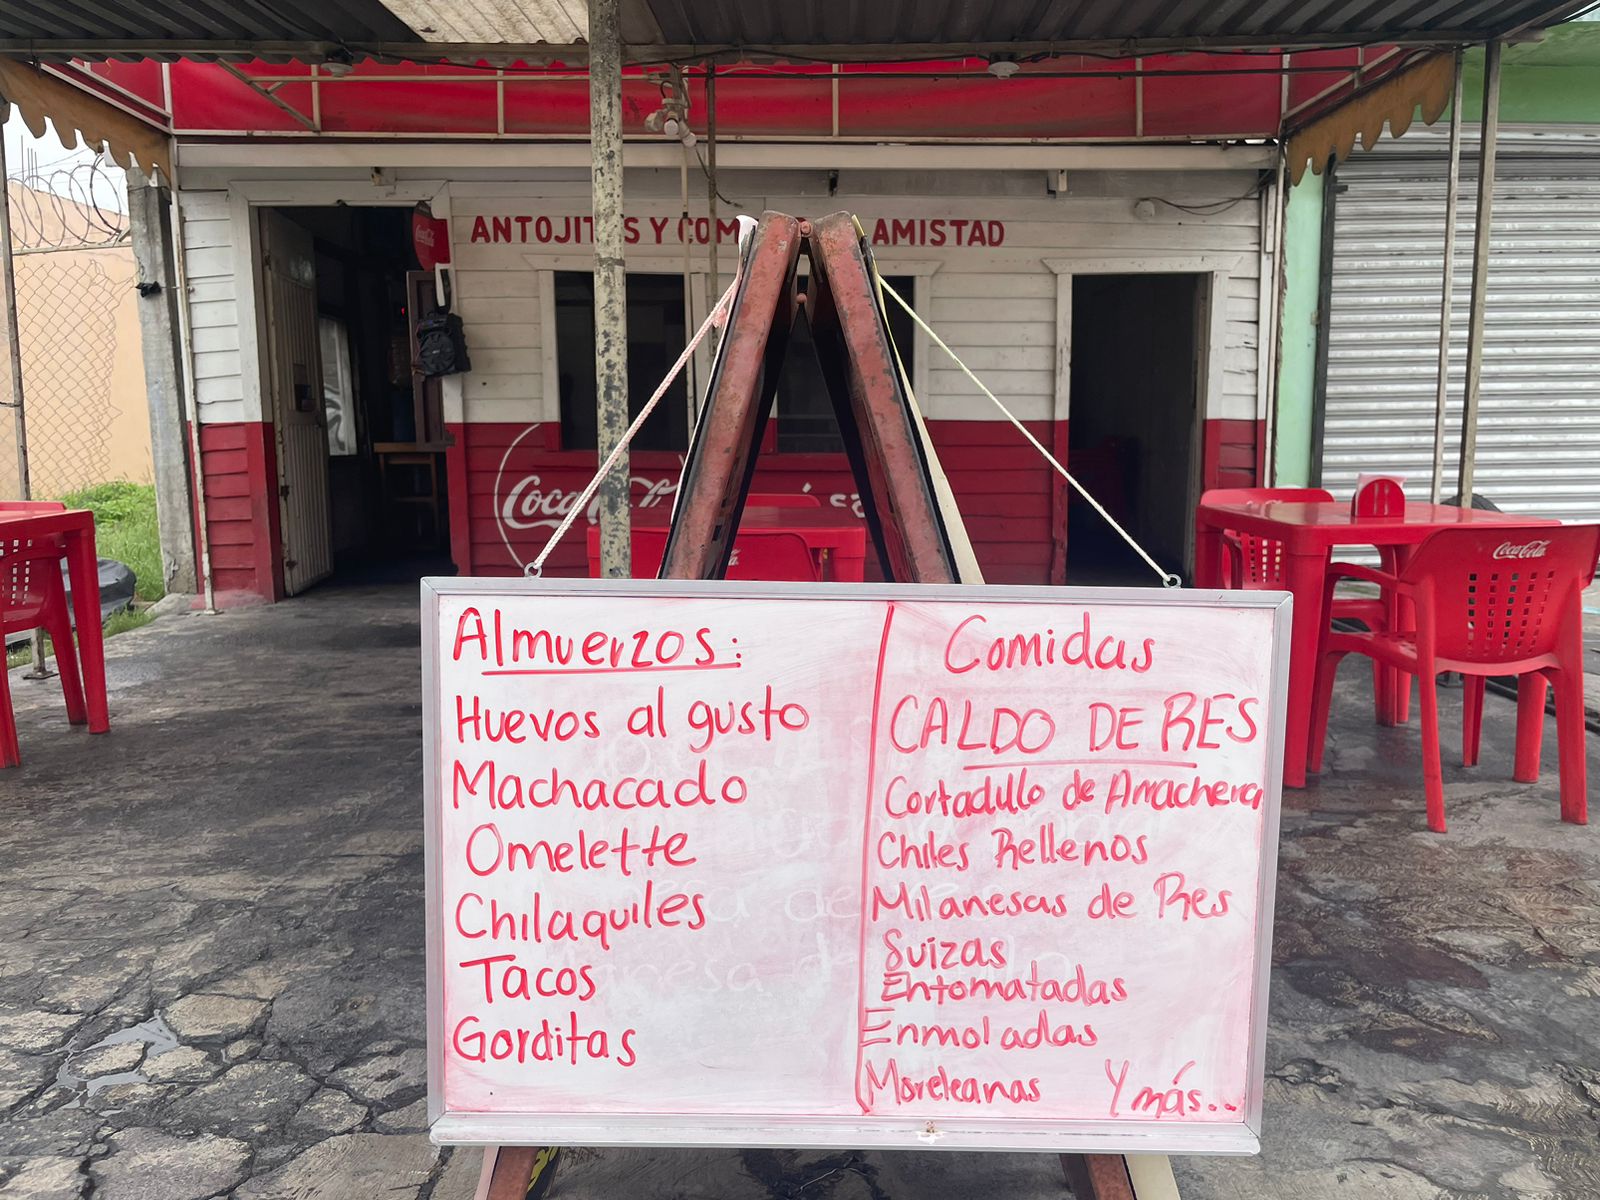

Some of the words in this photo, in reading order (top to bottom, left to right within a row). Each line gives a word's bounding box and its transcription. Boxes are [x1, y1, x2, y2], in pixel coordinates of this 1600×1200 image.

[471, 216, 640, 244] ANTOJITS
[649, 217, 669, 244] Y
[872, 218, 1005, 246] AMISTAD
[452, 606, 742, 668] Almuerzos:
[944, 611, 1155, 675] Comidas
[455, 695, 602, 744] Huevos
[626, 686, 667, 738] al
[687, 685, 810, 753] gusto
[889, 694, 1056, 754] CALDO
[1088, 702, 1144, 752] DE
[1161, 691, 1259, 752] RES
[452, 759, 748, 811] Machacado
[885, 766, 1045, 819] Cortadillo
[1062, 769, 1095, 811] de
[1105, 768, 1264, 815] Arrachera
[466, 822, 697, 876] Omelette
[877, 830, 970, 872] Chiles
[991, 822, 1149, 871] Rellenos
[455, 880, 706, 951] Chilaquiles
[872, 882, 1067, 922] Milanesas
[1087, 883, 1136, 920] de
[1153, 871, 1233, 921] Res
[882, 928, 1008, 969] Suizas
[459, 954, 597, 1004] Tacos
[881, 960, 1128, 1006] Entomatadas
[452, 1011, 636, 1067] Gorditas
[862, 1007, 1099, 1050] Enmoladas
[1105, 1058, 1130, 1117] Y
